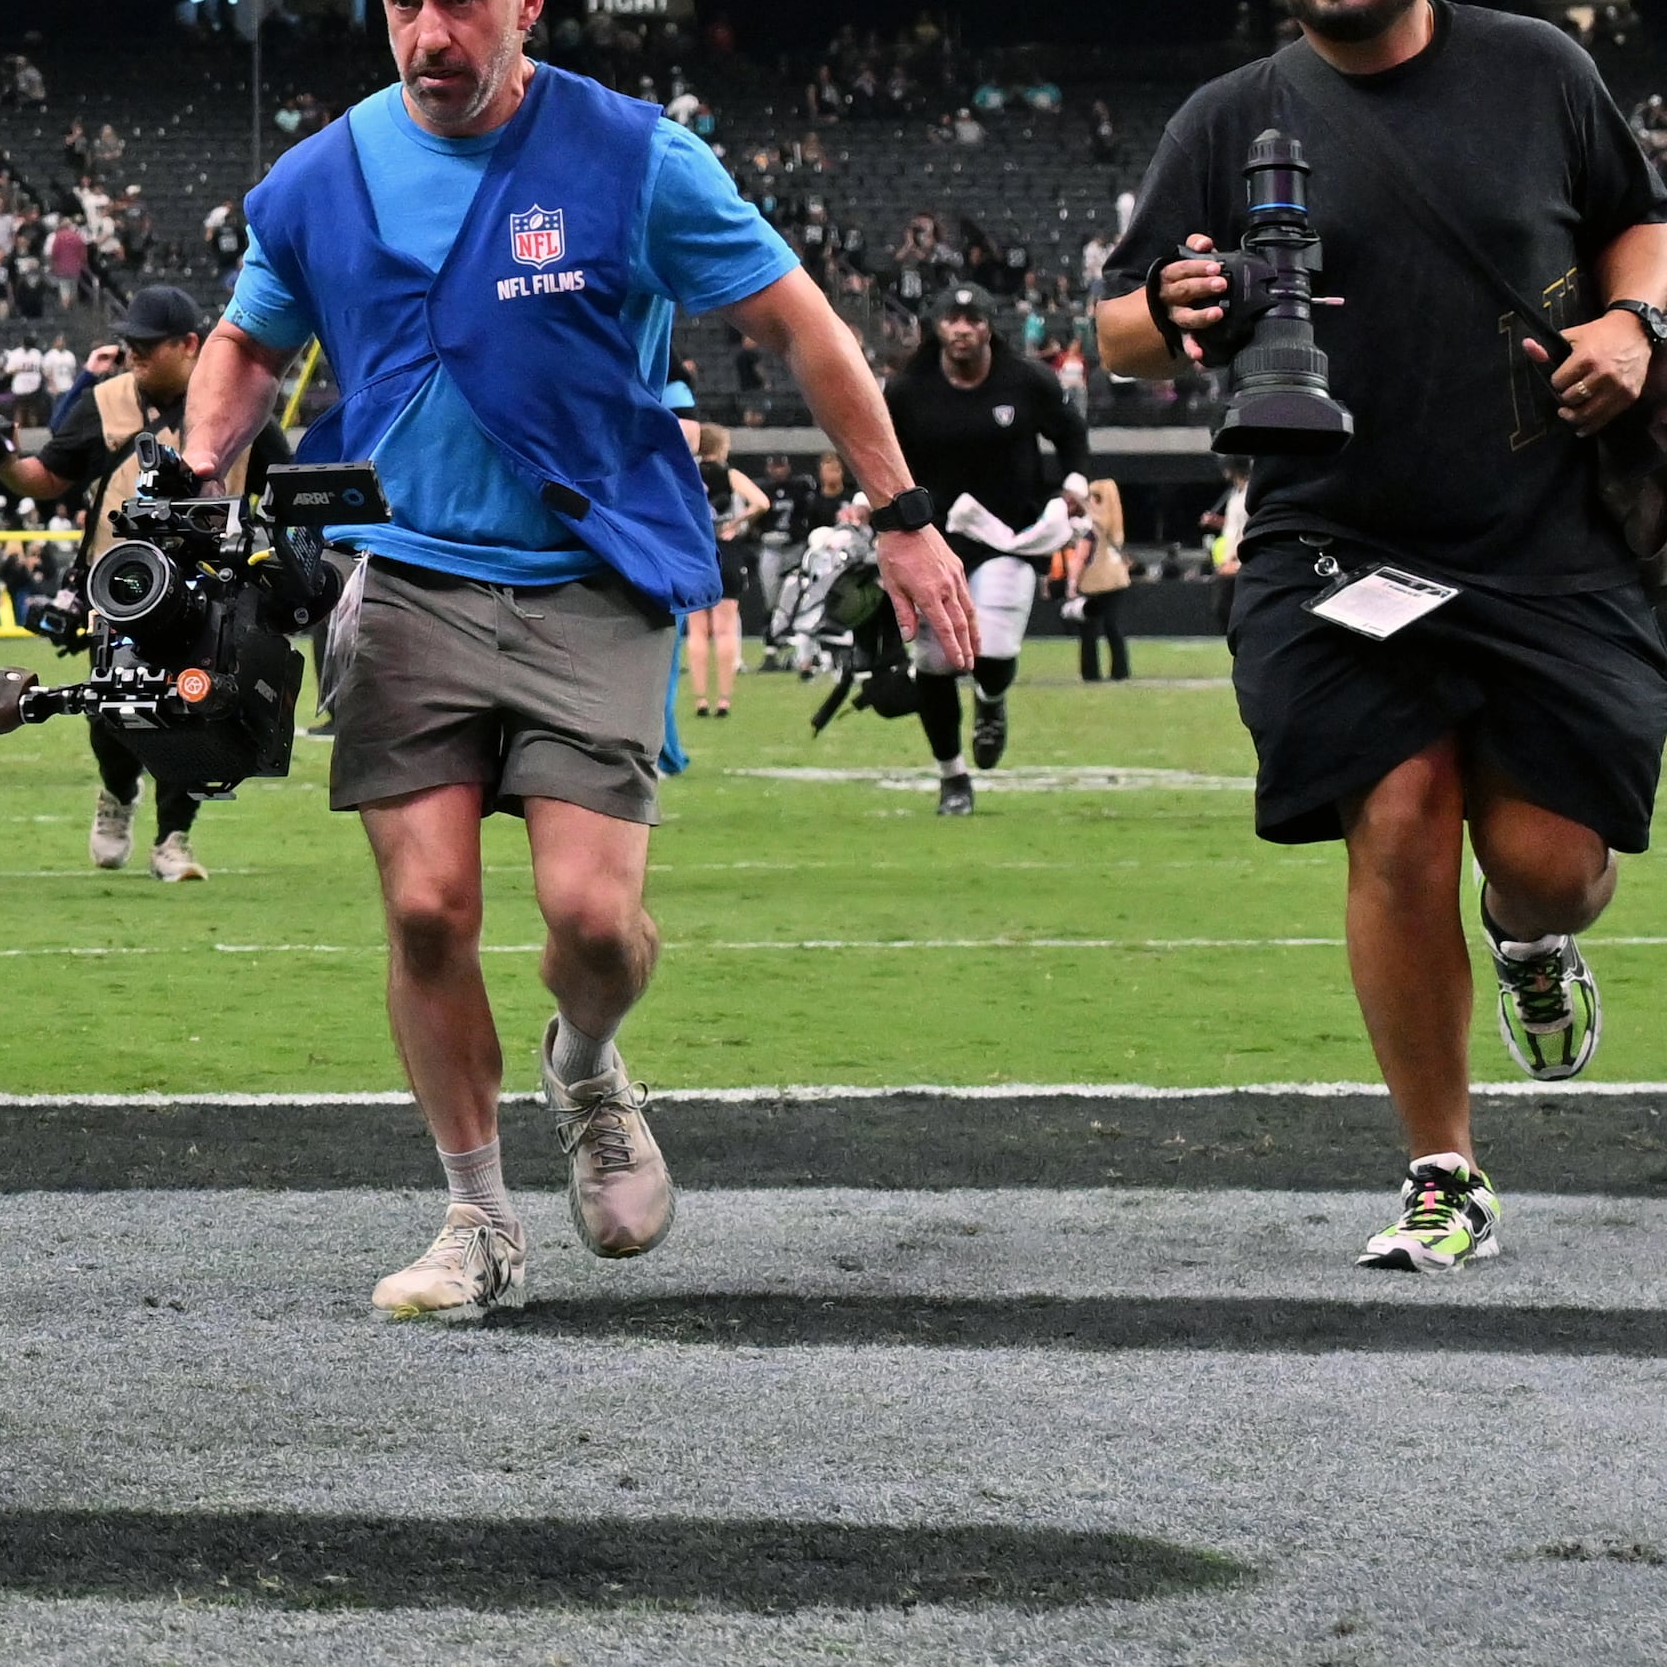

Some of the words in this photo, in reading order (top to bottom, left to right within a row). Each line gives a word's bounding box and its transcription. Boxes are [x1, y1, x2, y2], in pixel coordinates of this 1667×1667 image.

[517, 232, 559, 260] NFL
[497, 276, 531, 301] NFL
[532, 270, 586, 295] FILMS
[293, 492, 330, 506] ARRI
